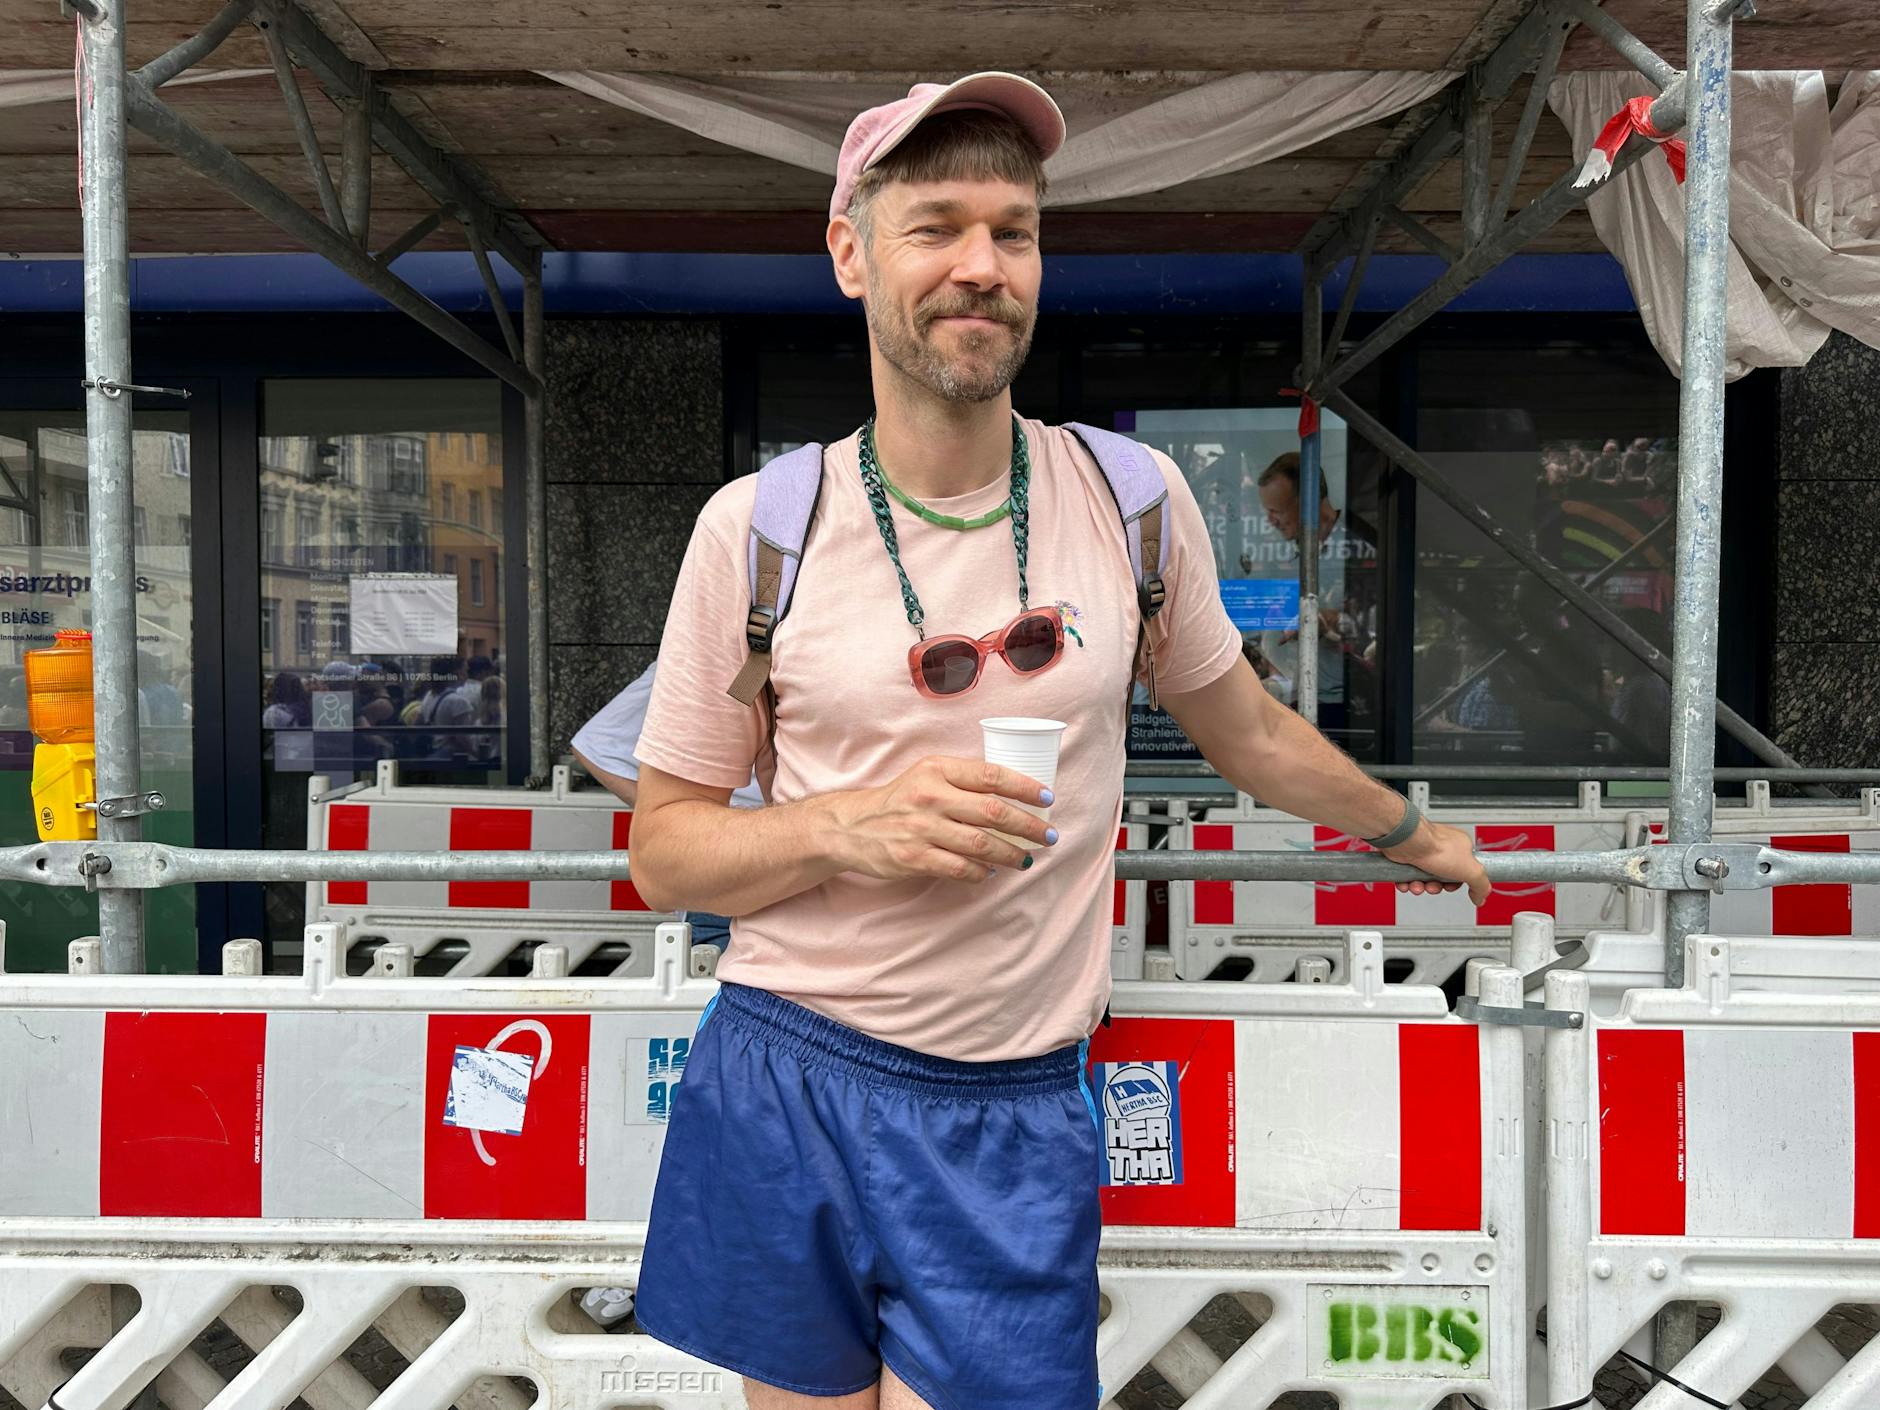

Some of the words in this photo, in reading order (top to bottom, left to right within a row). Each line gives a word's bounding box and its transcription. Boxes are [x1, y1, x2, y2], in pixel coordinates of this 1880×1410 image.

[1, 608, 50, 625] BLÄSE
[311, 672, 355, 682] Potsdamer
[357, 672, 386, 682] Straße
[405, 672, 432, 682] 10785
[433, 672, 458, 682] Berlin
[1131, 741, 1195, 752] innovativen
[1121, 1097, 1148, 1113] HERTHA
[1105, 1116, 1171, 1150] HER
[1107, 1147, 1174, 1181] THA
[1329, 1302, 1482, 1364] BBS
[601, 1355, 723, 1394] nissen
